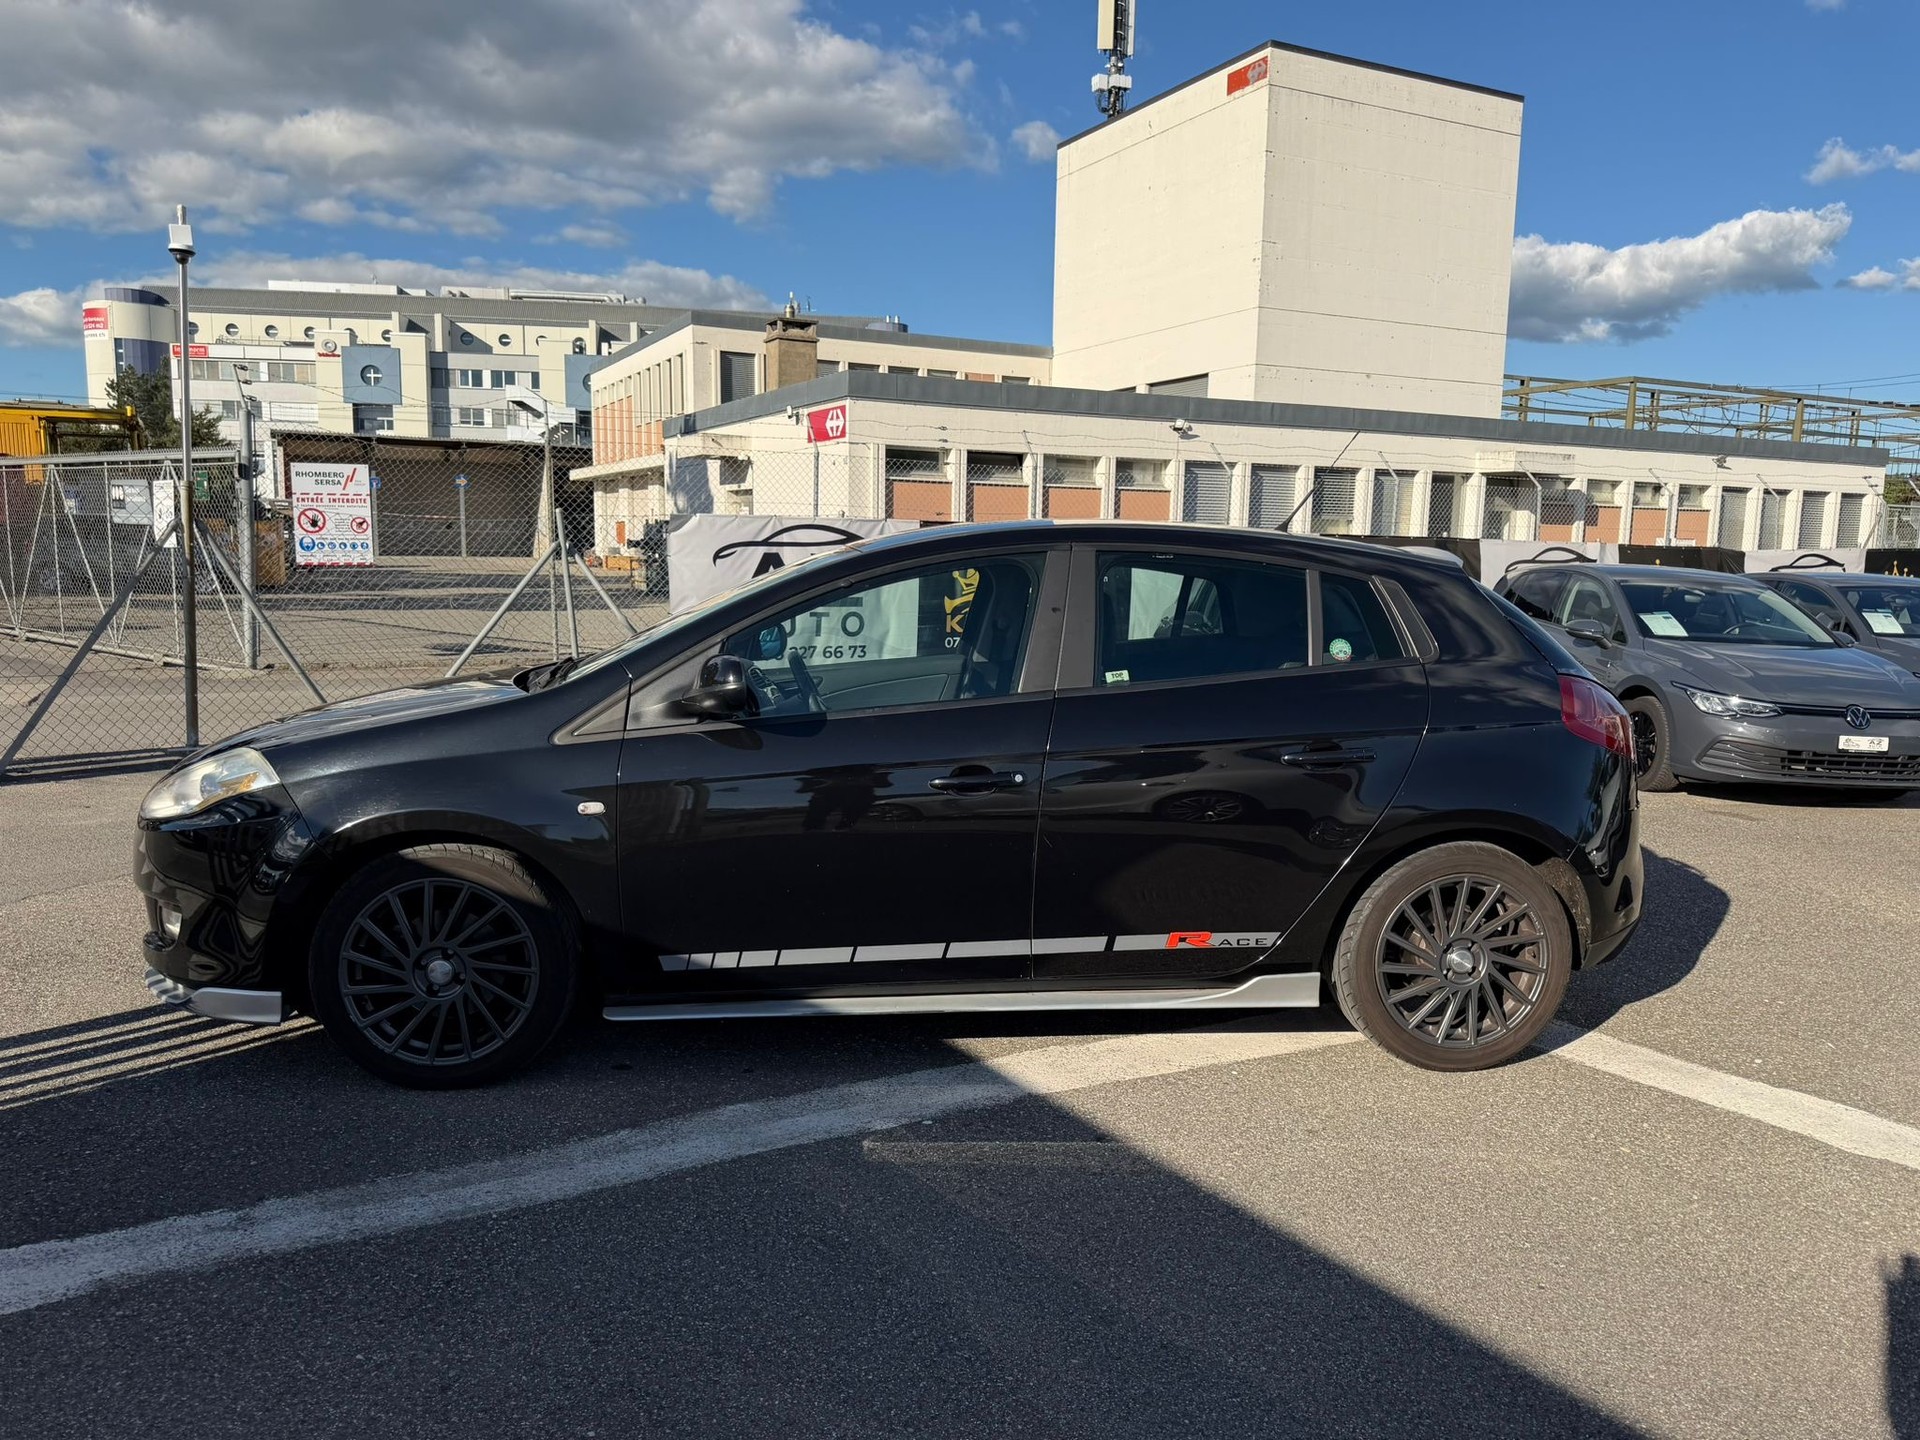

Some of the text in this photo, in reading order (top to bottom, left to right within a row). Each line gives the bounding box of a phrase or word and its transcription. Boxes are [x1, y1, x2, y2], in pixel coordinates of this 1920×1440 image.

[295, 470, 345, 479] RHOMBERG
[314, 478, 343, 486] SERSA
[822, 645, 844, 659] 66
[848, 644, 867, 659] 73
